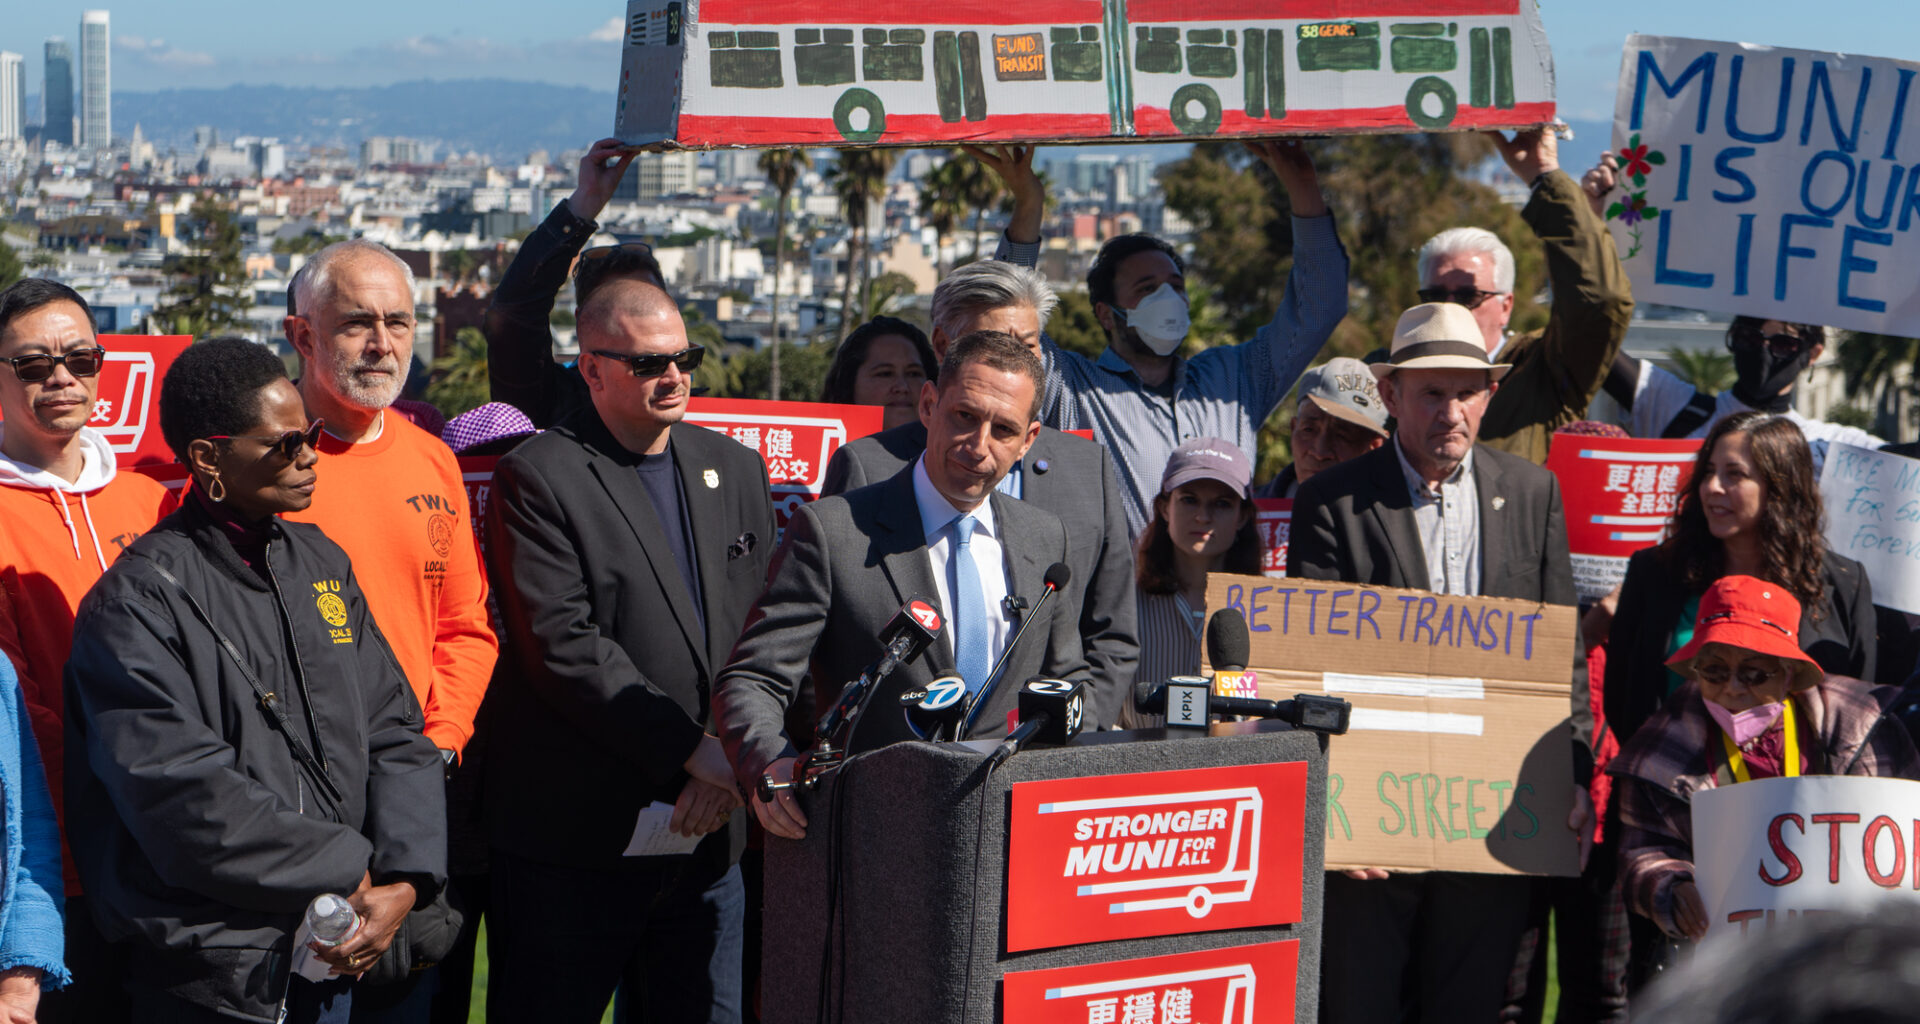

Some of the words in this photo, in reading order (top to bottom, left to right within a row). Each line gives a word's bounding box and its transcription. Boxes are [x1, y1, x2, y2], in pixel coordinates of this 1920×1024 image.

[996, 36, 1036, 54] FUND
[1301, 25, 1319, 38] 38
[996, 54, 1044, 72] TRANSIT
[1630, 51, 1917, 160] MUNI
[1673, 144, 1756, 203] IS
[1655, 209, 1893, 313] LIFE
[1604, 464, 1680, 493] 更穩健
[1833, 450, 1884, 485] FREE
[912, 607, 937, 628] 4
[1227, 584, 1381, 640] BETTER
[1398, 595, 1542, 660] TRANSIT
[901, 692, 927, 700] abc
[1221, 676, 1254, 689] SKY
[1182, 691, 1193, 720] KPIX
[1327, 773, 1353, 841] R
[1377, 771, 1539, 843] STREETS
[1074, 807, 1228, 841] STRONGER
[1063, 838, 1178, 877] MUNI
[1181, 836, 1216, 851] FOR
[1178, 850, 1211, 867] ALL
